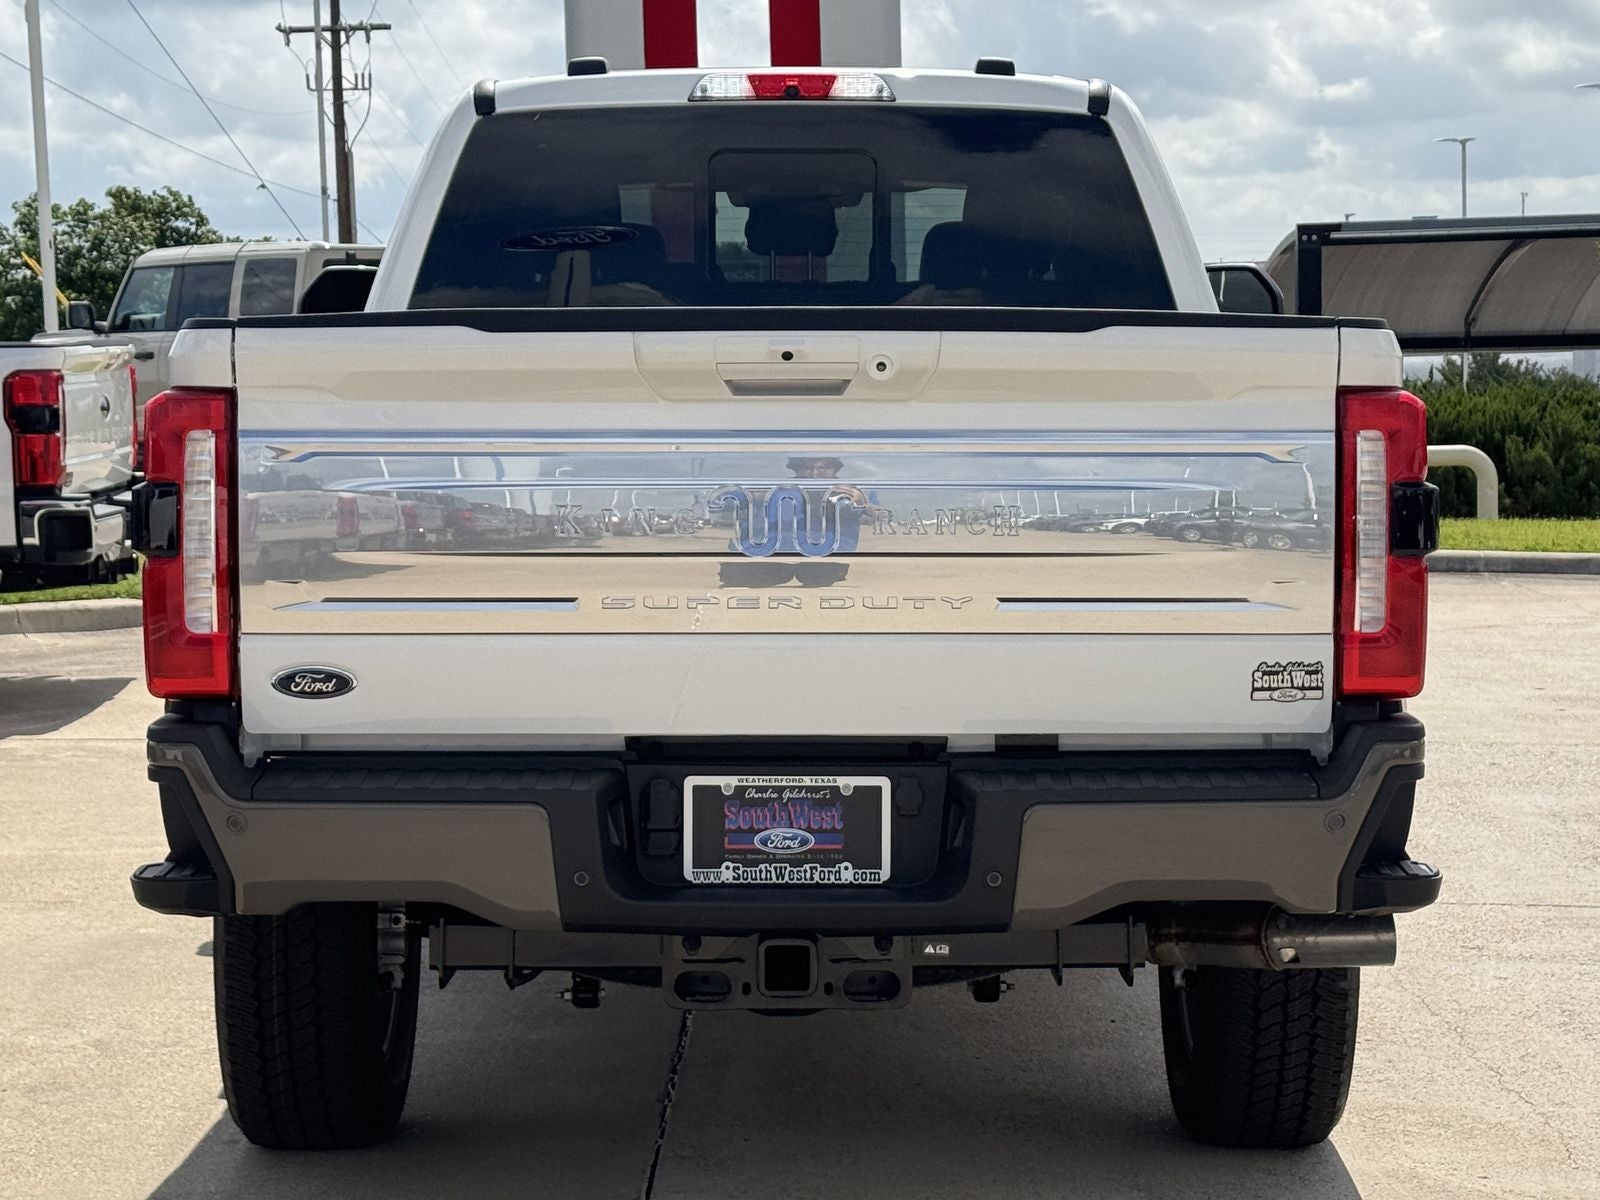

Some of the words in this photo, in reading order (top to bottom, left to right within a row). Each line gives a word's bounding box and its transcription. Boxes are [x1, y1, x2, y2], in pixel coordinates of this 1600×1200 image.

[555, 504, 698, 538] KING
[872, 505, 1020, 537] RANCH
[601, 595, 802, 610] SUPER
[819, 595, 974, 610] DUTY
[290, 672, 337, 692] Ford
[1253, 671, 1323, 688] SouthWest
[1277, 689, 1298, 700] Ford
[744, 787, 779, 799] Charlie
[724, 800, 844, 830] SouthWest
[767, 832, 802, 848] Ford
